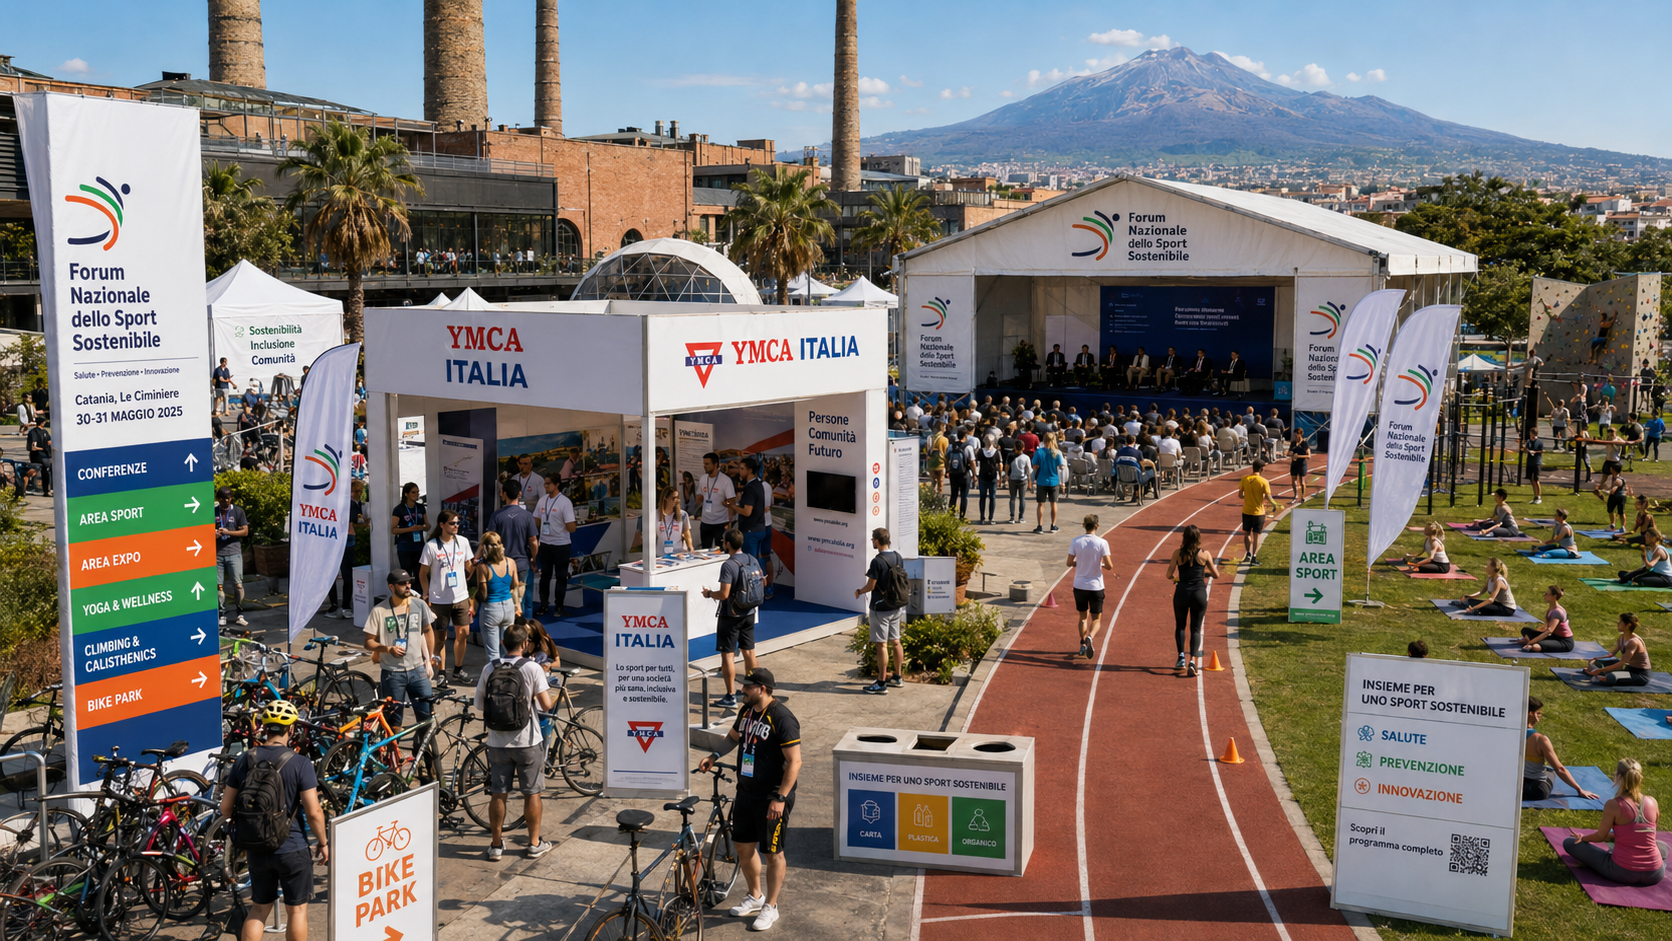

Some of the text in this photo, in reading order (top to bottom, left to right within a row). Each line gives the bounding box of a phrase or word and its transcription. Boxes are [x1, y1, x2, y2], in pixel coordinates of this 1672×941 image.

[1128, 212, 1166, 223] Forum
[1128, 225, 1187, 236] Nazionale
[1128, 238, 1187, 250] dello Sport
[1128, 251, 1190, 261] Sostenibile
[69, 262, 125, 280] Forum
[70, 286, 150, 304] Nazionale
[72, 309, 157, 330] dello Sport
[249, 324, 302, 336] Sostenibilità
[447, 325, 523, 352] YMCA
[72, 332, 161, 352] Sostenibile
[250, 339, 295, 350] Inclusione
[690, 336, 859, 365] YMCA YMCA ITALIA
[1309, 344, 1334, 352] Forum
[251, 354, 295, 365] Comunità
[74, 366, 180, 380] Salute Prevenzione Innovazione
[446, 359, 528, 388] ITALIA
[75, 388, 180, 407] Catania, Le Ciminiere
[76, 406, 183, 425] 30-31 MAGGIO 2025
[809, 411, 849, 426] Persone
[1389, 421, 1413, 431] Forum
[809, 428, 856, 443] Comunità
[809, 443, 842, 458] Futuro
[1404, 443, 1425, 453] Sport
[78, 462, 147, 480] CONFERENZE
[80, 507, 144, 526] AREA SPORT
[300, 504, 337, 522] YMCA
[298, 521, 338, 540] ITALIA
[81, 552, 141, 571] AREA EXPO
[1299, 552, 1335, 564] AREA
[1296, 568, 1337, 580] SPORT
[83, 591, 172, 616] YOGA & WELLNESS
[622, 615, 669, 628] YMCA
[85, 636, 140, 656] CLIMBING &
[616, 633, 675, 648] ITALIA
[85, 648, 156, 673] CALISTHENICS
[1362, 679, 1435, 696] INSIEME PER
[88, 689, 143, 712] BIKE PARK
[1361, 694, 1506, 718] UNO SPORT SOSTENIBILE
[1381, 730, 1427, 745] SALUTE
[1380, 756, 1464, 776] PREVENZIONE
[849, 772, 1006, 791] INSIEME PER UNO SPORT SOSTENIBILE
[1378, 783, 1463, 804] INNOVAZIONE
[860, 830, 882, 838] CARTA
[908, 834, 939, 843] PLASTICA
[1350, 823, 1385, 836] Scopri il
[962, 838, 996, 847] ORGANICO
[1349, 836, 1444, 857] programma completo
[359, 853, 414, 898] BIKE
[356, 880, 417, 928] PARK
